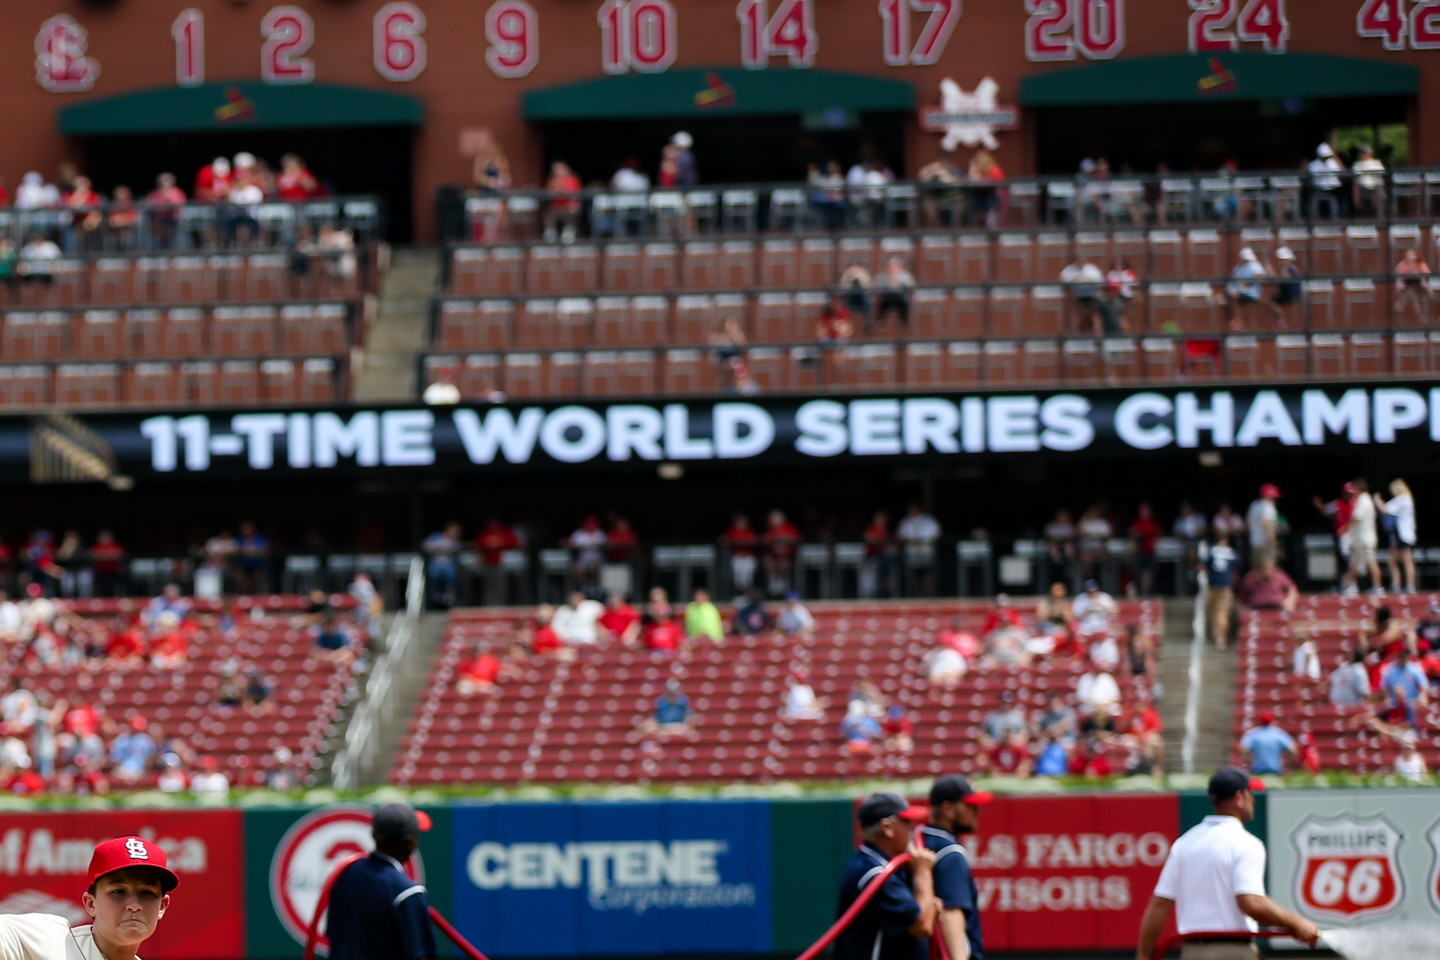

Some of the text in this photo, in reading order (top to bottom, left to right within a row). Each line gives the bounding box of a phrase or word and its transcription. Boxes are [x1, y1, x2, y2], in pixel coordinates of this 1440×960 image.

[172, 8, 205, 87] 1
[260, 6, 314, 85] 2
[373, 2, 427, 81] 6
[484, 0, 539, 78] 9
[597, 0, 677, 74] 10
[736, 0, 816, 69] 14
[880, 0, 962, 66] 17
[1024, 0, 1125, 62] 20
[1187, 0, 1289, 54] 24
[142, 410, 435, 471] 11-TIME
[453, 403, 773, 463] WORLD
[795, 395, 1094, 455] SERIES
[1024, 831, 1169, 868] FARGO
[1307, 831, 1387, 848] PHILLIPS
[467, 840, 720, 890] CENTENE
[1311, 859, 1385, 906] 66
